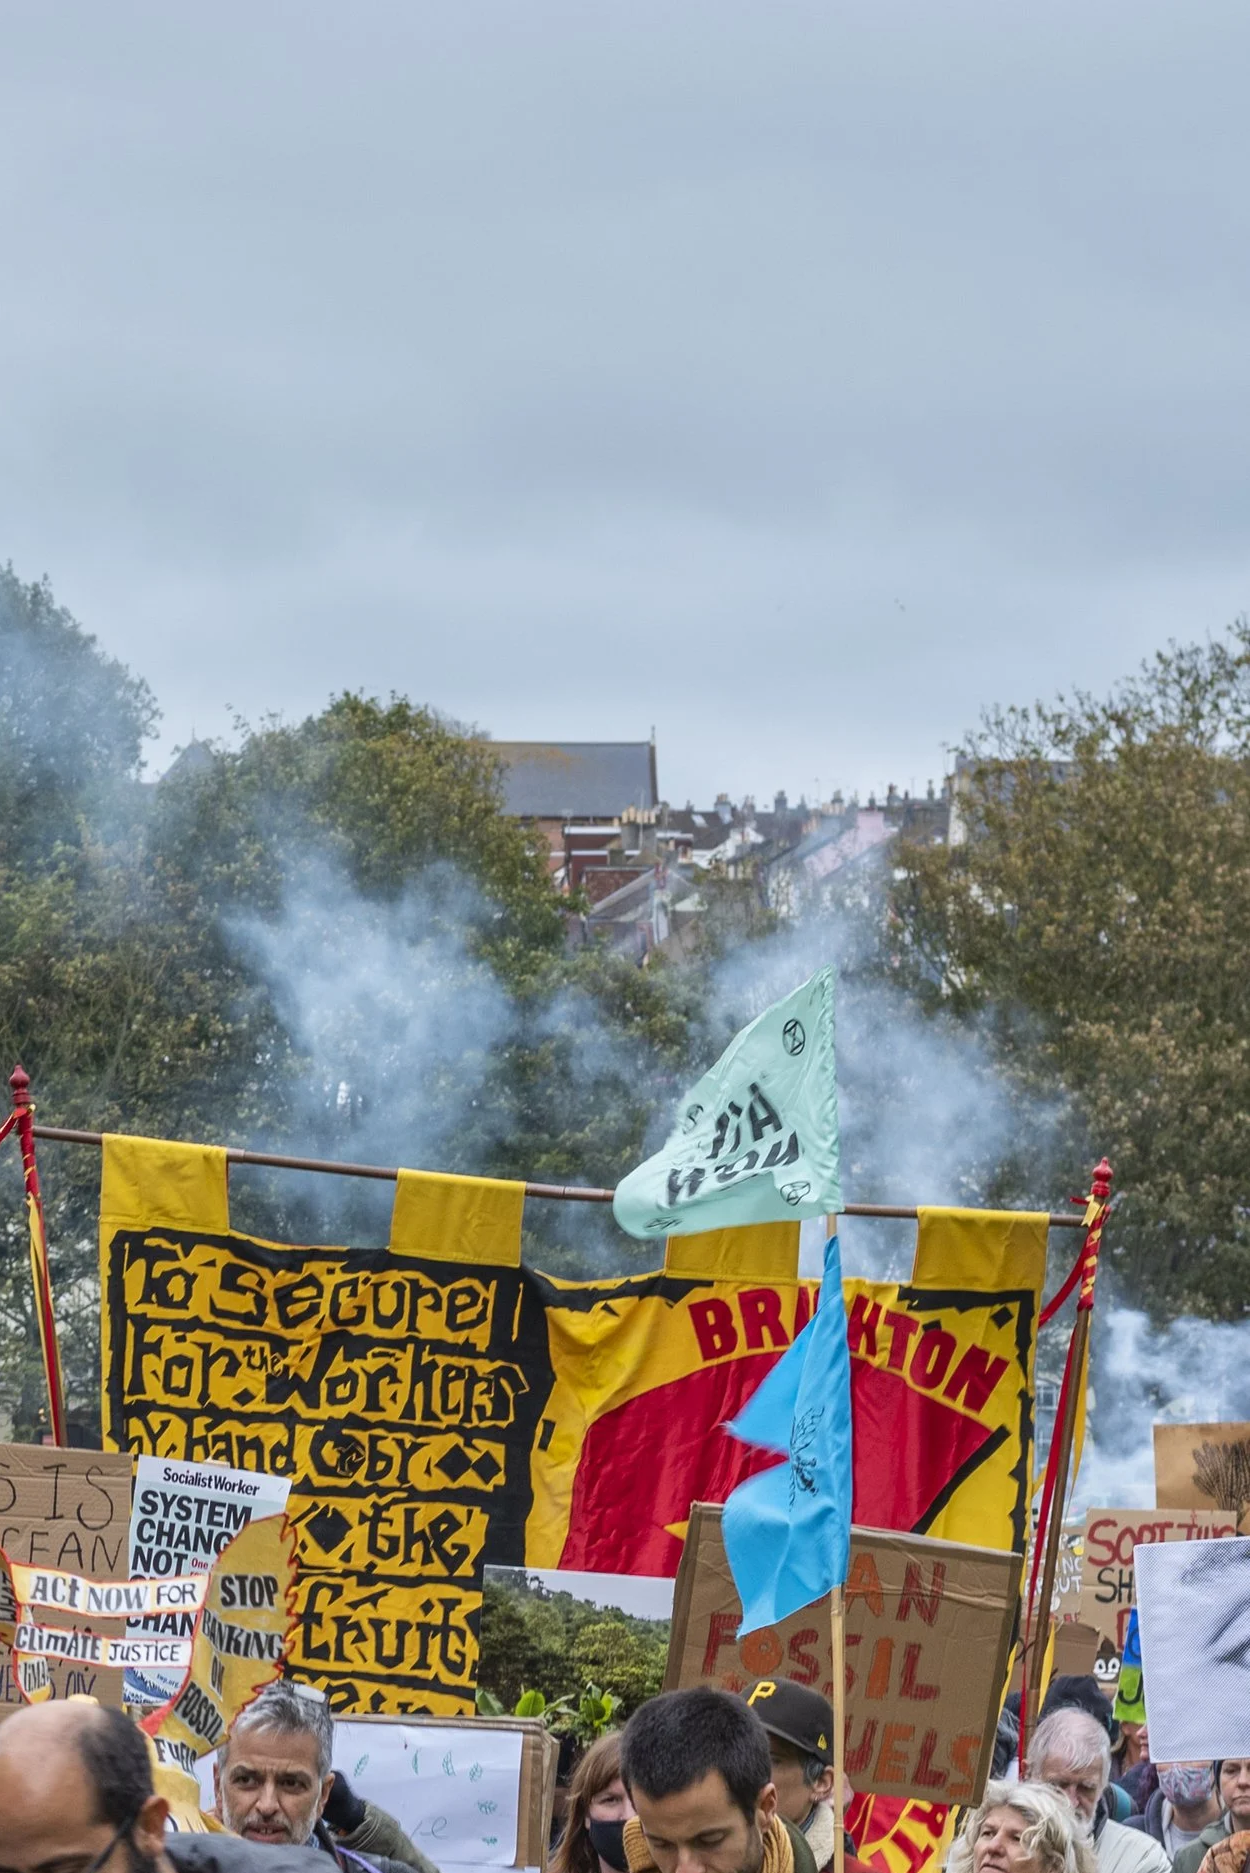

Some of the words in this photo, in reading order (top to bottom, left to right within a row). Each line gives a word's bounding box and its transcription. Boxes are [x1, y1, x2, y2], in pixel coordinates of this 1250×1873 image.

[688, 1287, 1010, 1413] BRIHTON
[43, 1464, 114, 1531] IS
[139, 1490, 253, 1531] SYSTEM
[136, 1518, 235, 1555] CHANG
[131, 1545, 188, 1577] NOT
[87, 1586, 150, 1612] NOW
[157, 1583, 197, 1608] FOR
[220, 1575, 279, 1607] STOP
[202, 1608, 283, 1660] BANKING
[702, 1612, 941, 1701] FOSSIL
[174, 1682, 223, 1746] FOSSIL
[747, 1681, 777, 1707] P
[844, 1715, 982, 1798] UELS
